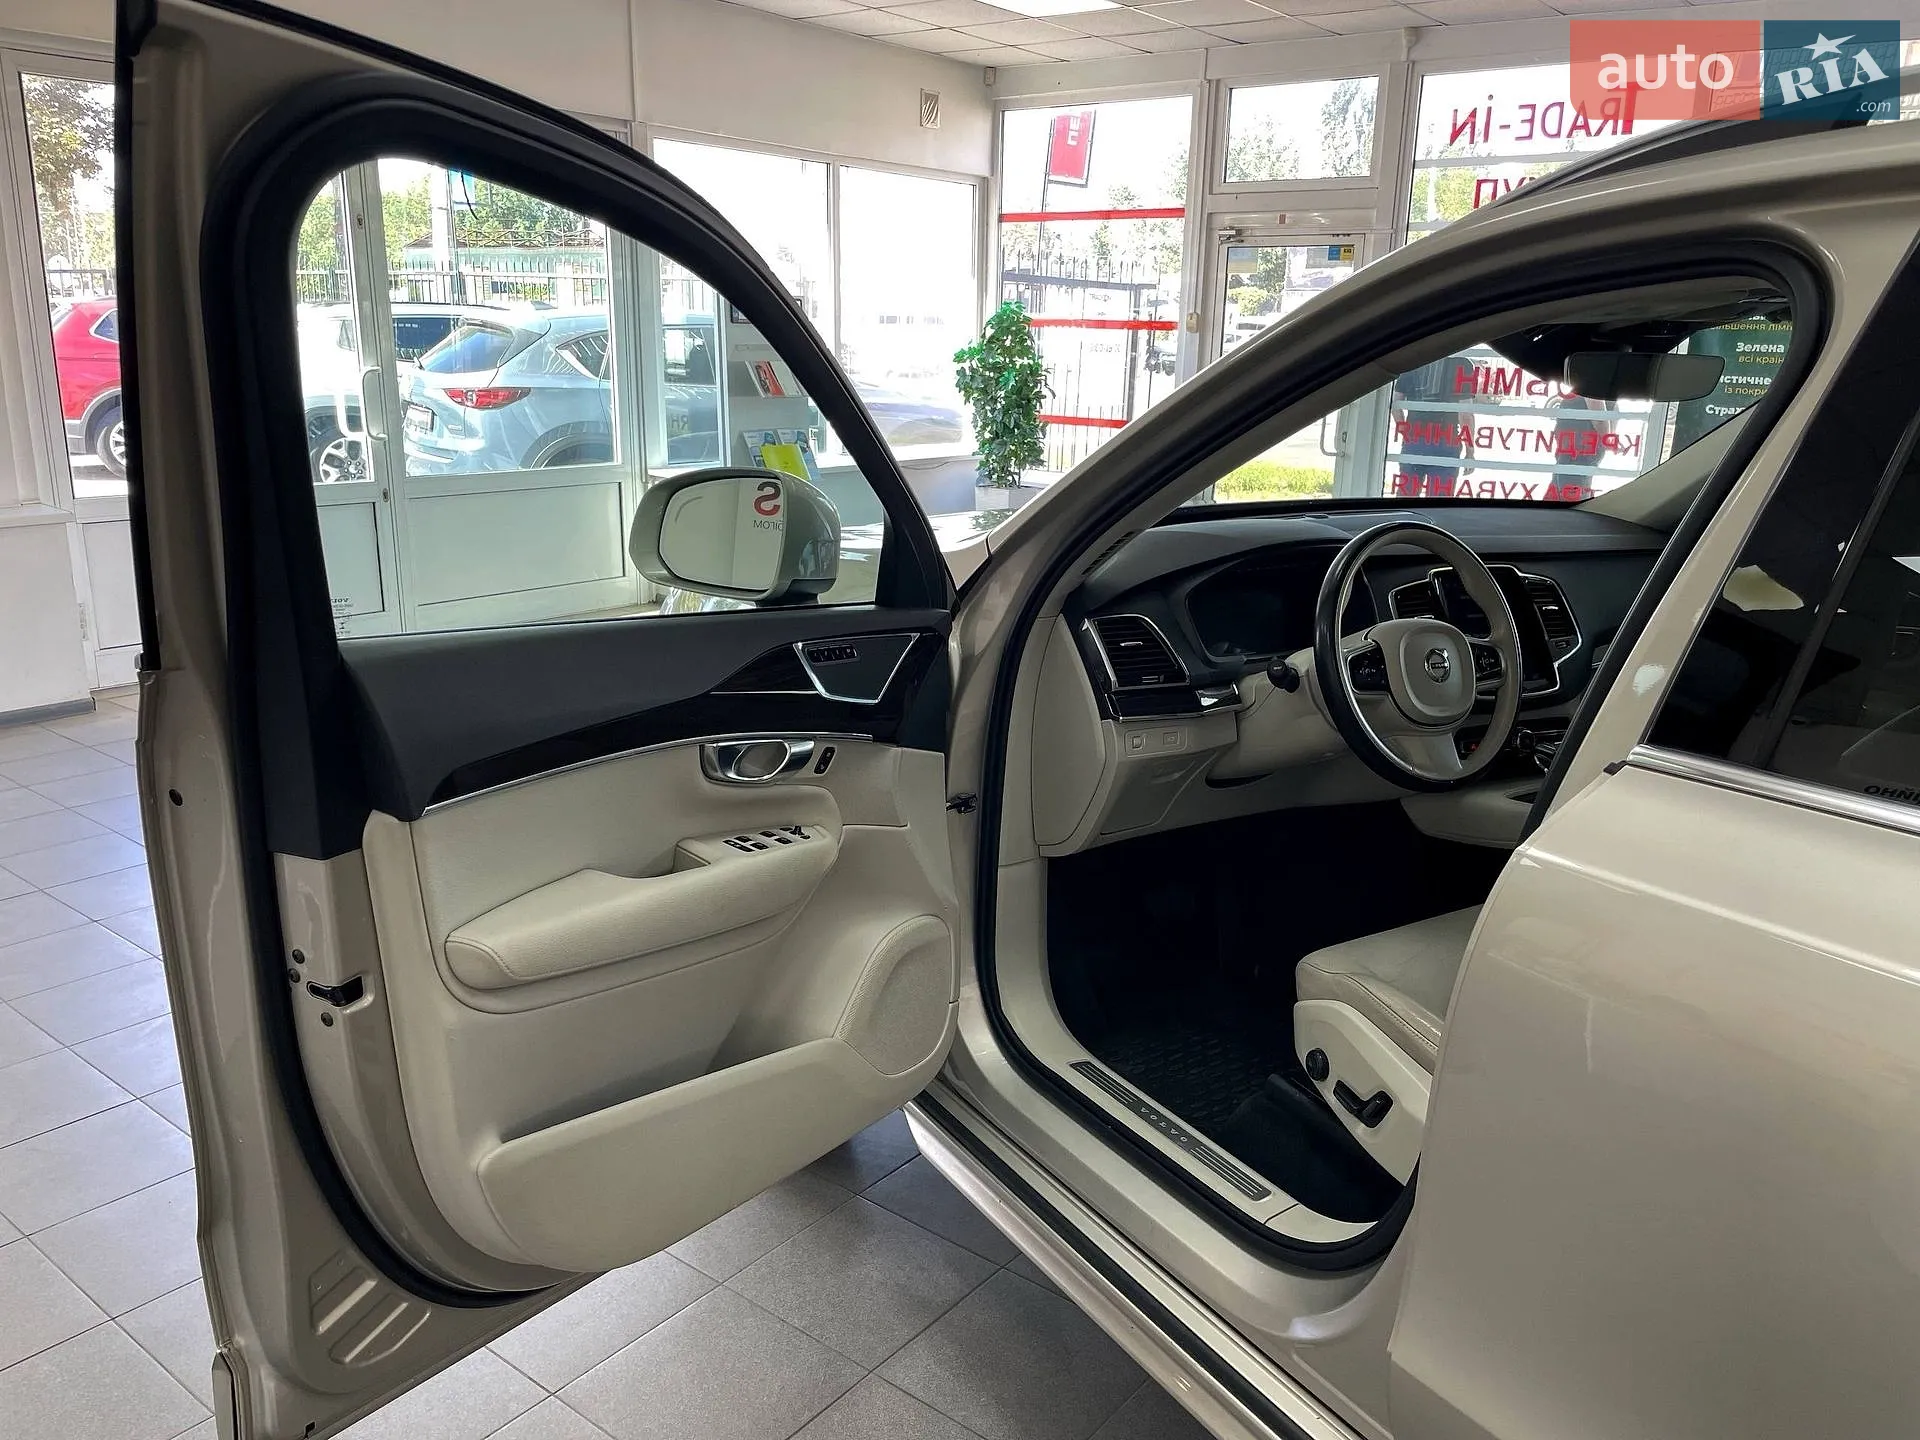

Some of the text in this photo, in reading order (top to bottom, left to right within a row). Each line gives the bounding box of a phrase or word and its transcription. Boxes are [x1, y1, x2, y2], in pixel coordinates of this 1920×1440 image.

[1735, 342, 1785, 353] Зелена
[1738, 354, 1784, 365] всі країн
[1705, 404, 1746, 417] Страх
[1140, 1107, 1188, 1142] VOLVO
